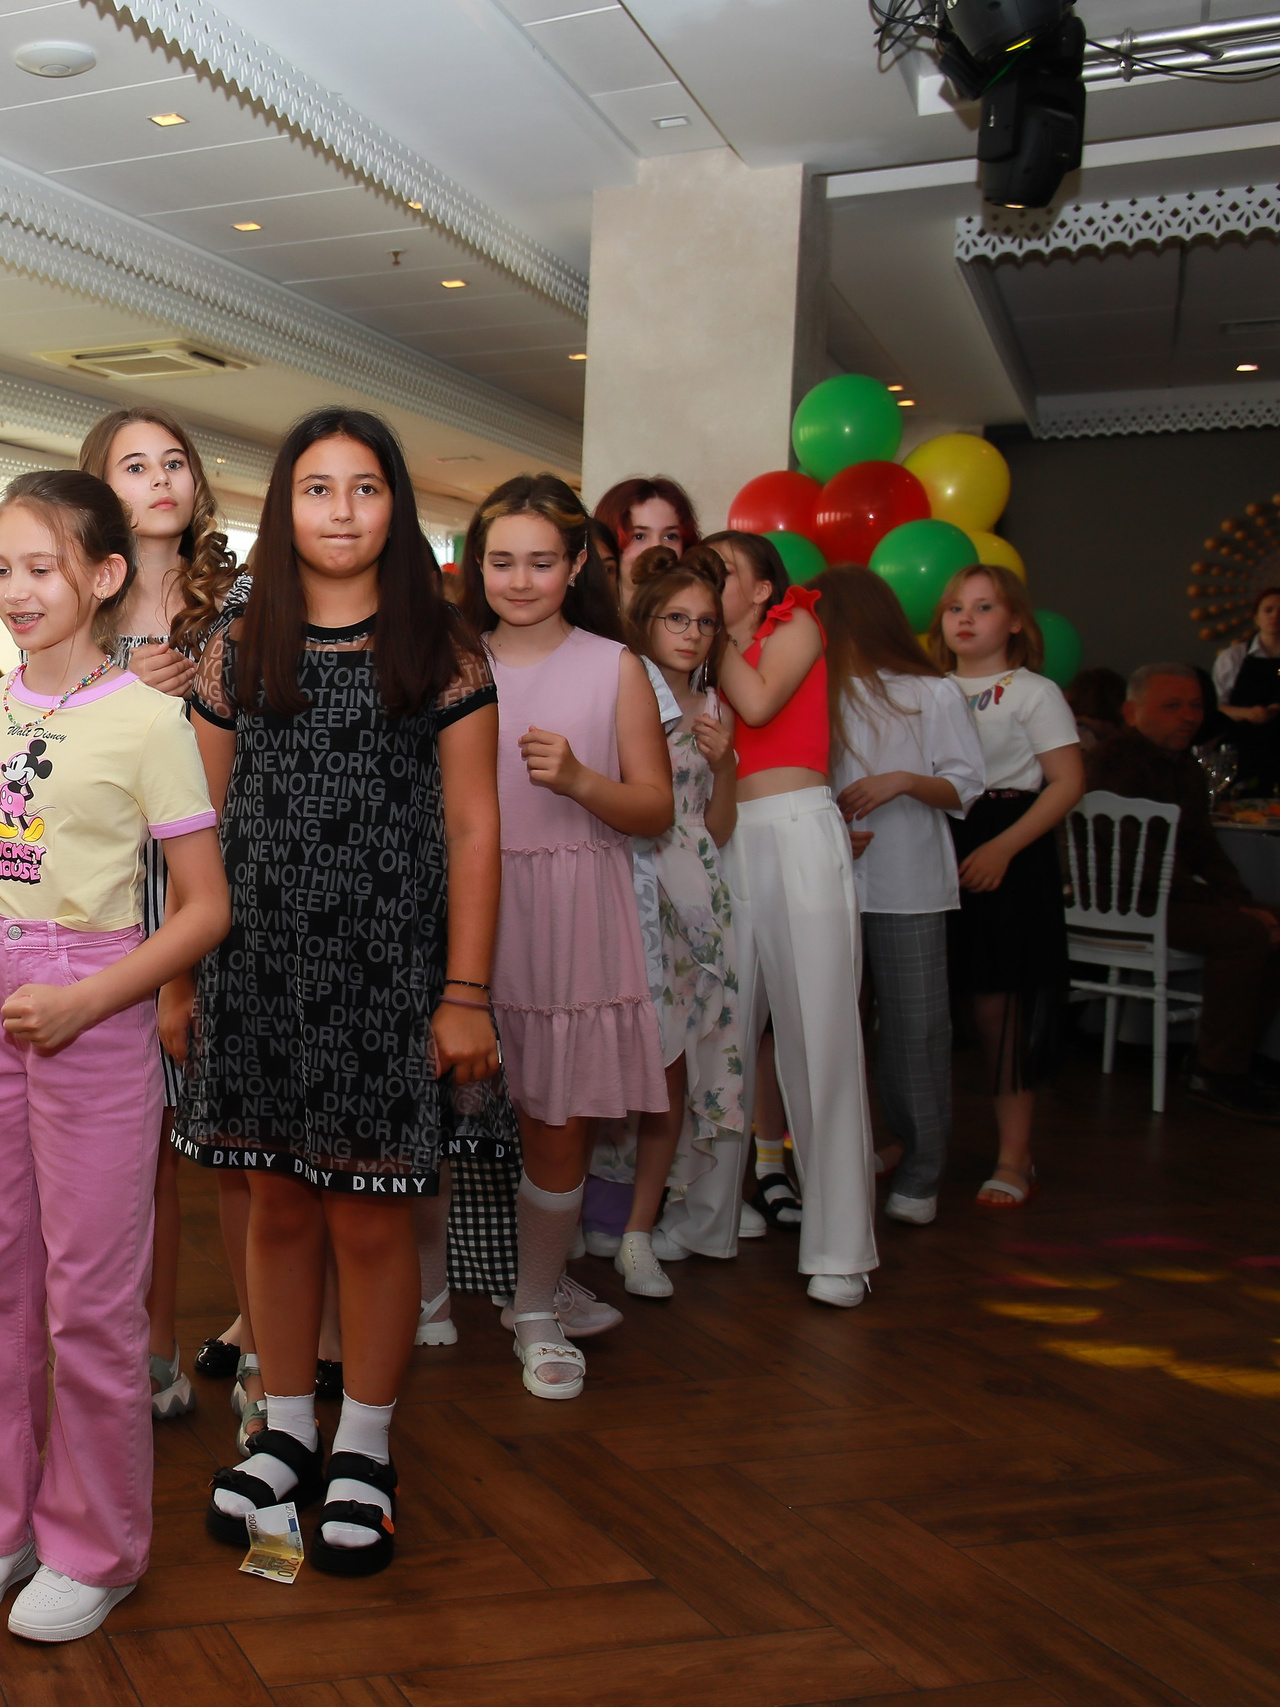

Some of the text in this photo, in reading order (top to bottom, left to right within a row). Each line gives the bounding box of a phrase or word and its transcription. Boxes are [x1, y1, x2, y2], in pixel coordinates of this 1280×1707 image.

[293, 707, 362, 729] KEEP
[7, 726, 67, 743] Walt Disney
[244, 728, 331, 751] MOVING
[358, 729, 421, 757] DKNY
[252, 750, 300, 773] NEW
[309, 750, 382, 776] YORK
[389, 754, 418, 781] OR
[244, 773, 264, 796] OR
[272, 772, 386, 802] NOTHING
[287, 795, 352, 821] KEEP
[359, 800, 382, 824] IT
[238, 816, 321, 842] MOVING
[348, 822, 414, 851] DKNY
[247, 840, 292, 863] NEW
[300, 841, 371, 871] YORK
[378, 848, 411, 875] OR
[235, 862, 258, 885] OR
[264, 864, 373, 896] NOTHING
[281, 886, 341, 914] KEEP
[347, 893, 369, 917] IT
[232, 905, 309, 934] MOVING
[337, 915, 406, 942] DKNY
[228, 949, 257, 973] OR
[244, 929, 290, 952] NEW
[296, 932, 358, 961] YORK
[366, 939, 403, 965] OR
[341, 983, 362, 1006] IT
[369, 984, 427, 1017] MOV
[241, 1014, 295, 1036] NEW
[302, 1023, 354, 1049] ORK
[361, 1028, 399, 1054] OR
[329, 1004, 401, 1032] DKNY
[224, 1033, 258, 1056] OR
[386, 1053, 437, 1081] KEE
[225, 1075, 304, 1099] MOVIN
[323, 1091, 396, 1119] DKNY
[333, 1070, 358, 1094] IT
[241, 1096, 298, 1118] NEW
[355, 1116, 392, 1140] OR
[227, 1117, 260, 1138] OR
[380, 1140, 432, 1168] KEE
[169, 1128, 200, 1160] DKNY
[212, 1149, 277, 1168] DKNY
[293, 1158, 333, 1187] DKNY
[351, 1175, 427, 1194] DKNY
[248, 1513, 257, 1531] 200
[277, 1559, 300, 1577] 200
